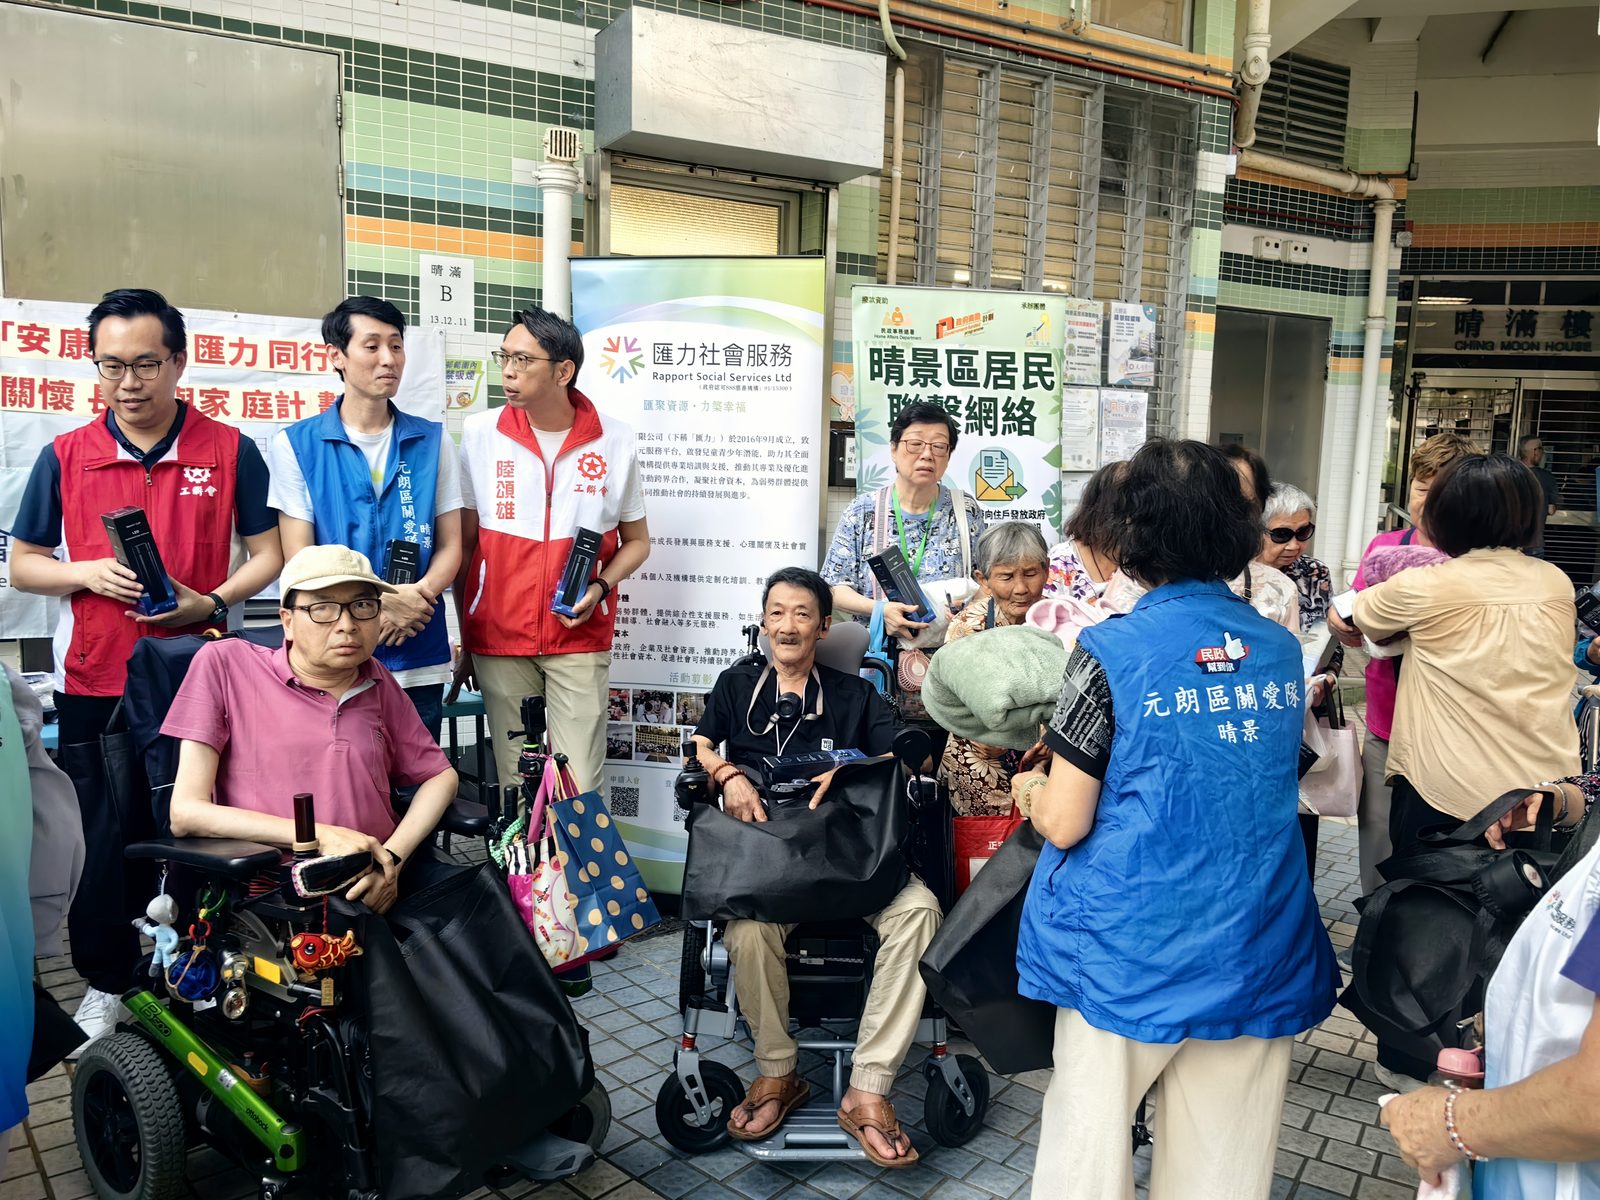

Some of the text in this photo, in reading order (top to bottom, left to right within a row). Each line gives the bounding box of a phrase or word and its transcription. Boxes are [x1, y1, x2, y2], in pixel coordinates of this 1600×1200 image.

[431, 264, 461, 279] 晴滿
[440, 285, 453, 302] B
[1454, 308, 1594, 339] 晴滿樓
[194, 334, 337, 373] 匯力同行
[653, 342, 792, 367] 匯力社會服務
[1454, 340, 1593, 352] CHING MOON HOUSE
[652, 372, 792, 383] Rapport Social Services Ltd
[868, 346, 1055, 391] 晴景區居民
[495, 460, 516, 520] 陸頌雄
[981, 509, 1046, 520] 向住戶發放政府
[1200, 648, 1227, 661] 民政
[1143, 680, 1301, 718] 元朗區關愛隊
[1217, 719, 1260, 744] 晴景
